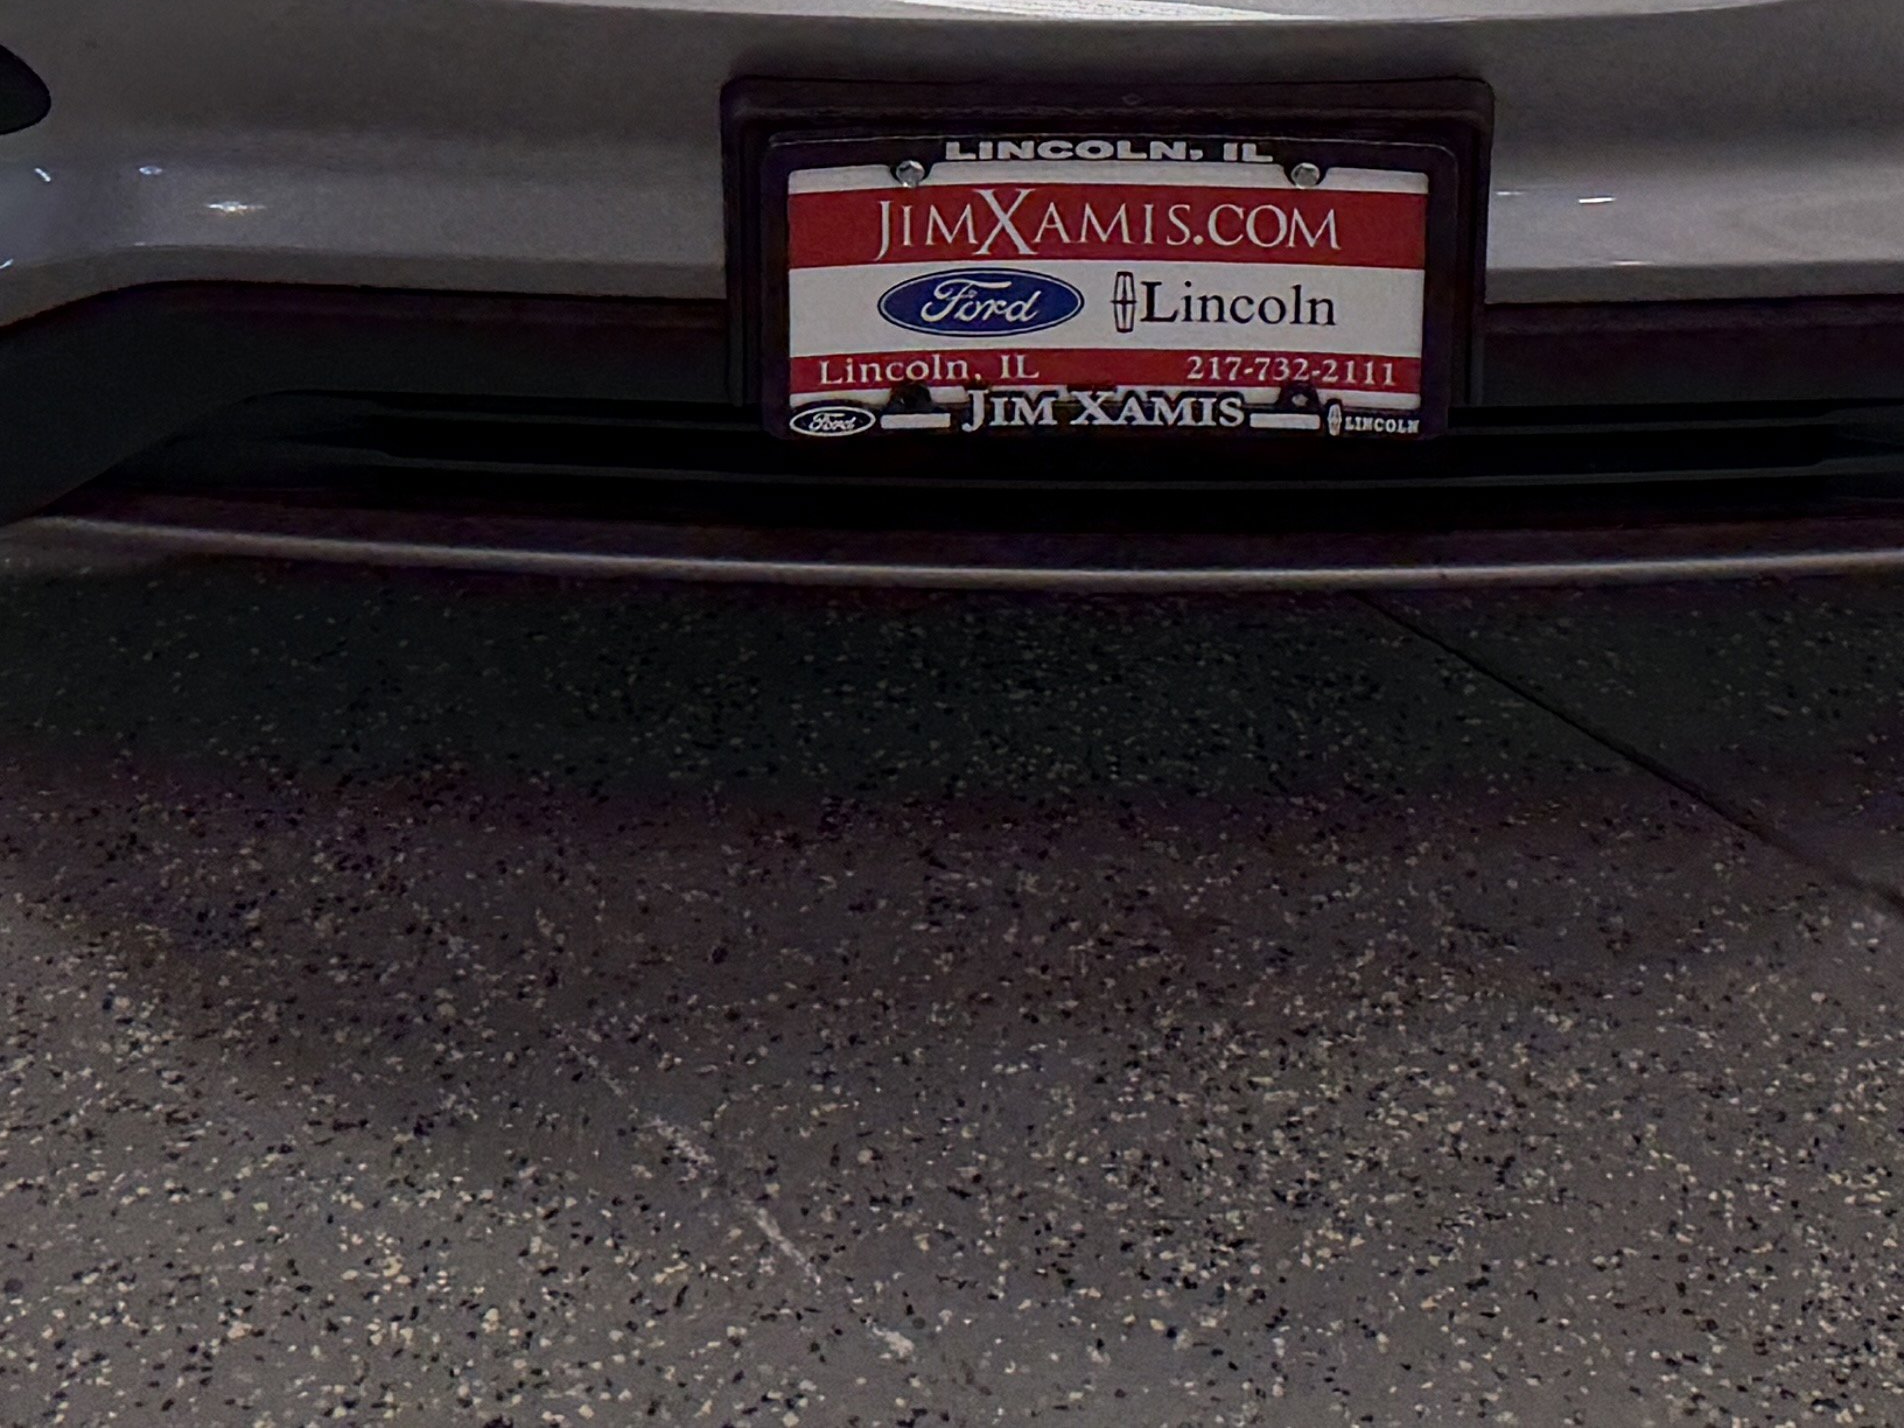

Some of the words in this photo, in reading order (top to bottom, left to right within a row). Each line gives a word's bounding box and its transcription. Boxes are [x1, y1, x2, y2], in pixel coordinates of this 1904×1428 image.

[945, 140, 1203, 161] LINCOLN,
[1223, 143, 1273, 163] IL
[919, 279, 1040, 325] Ford
[1139, 280, 1337, 327] Lincoln
[999, 354, 1040, 379] IL
[1186, 355, 1396, 386] 217-732-2111
[807, 411, 857, 432] Ford
[961, 389, 1059, 433] JIM
[1068, 389, 1246, 428] XAMIS
[1344, 415, 1421, 435] LINCOLN
